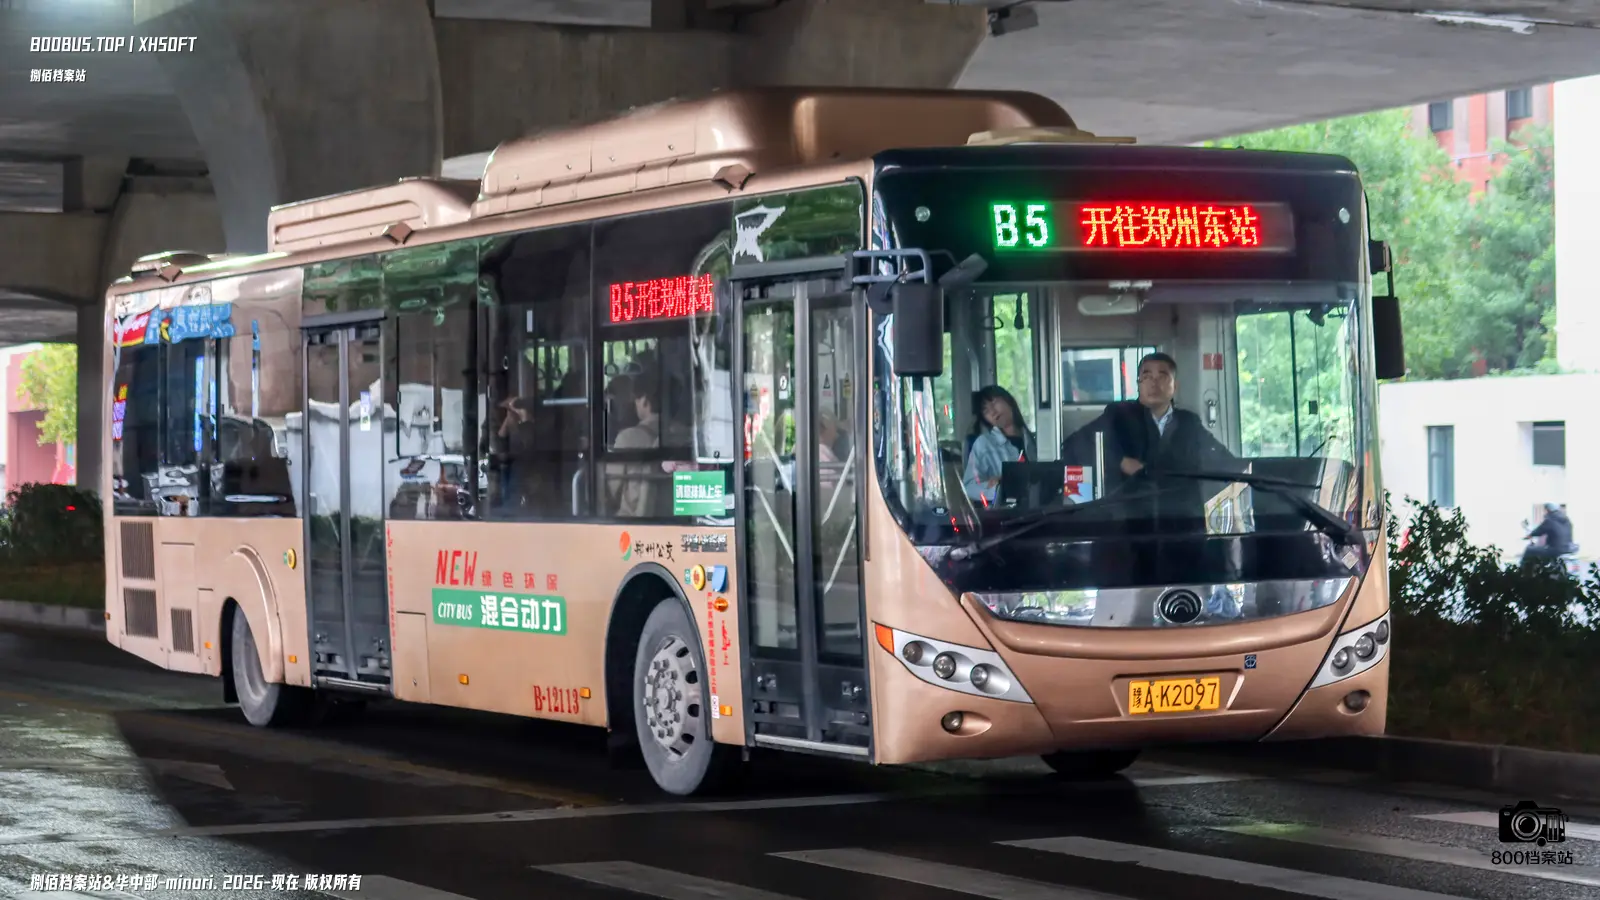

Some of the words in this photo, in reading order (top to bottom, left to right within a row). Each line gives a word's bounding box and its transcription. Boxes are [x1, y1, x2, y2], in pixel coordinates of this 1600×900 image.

[993, 204, 1048, 247] B5
[1082, 205, 1258, 248] 开往郑州东站
[435, 549, 478, 586] NEW
[437, 602, 456, 619] CITY
[456, 603, 473, 620] BUS
[480, 595, 562, 632] 混合动力
